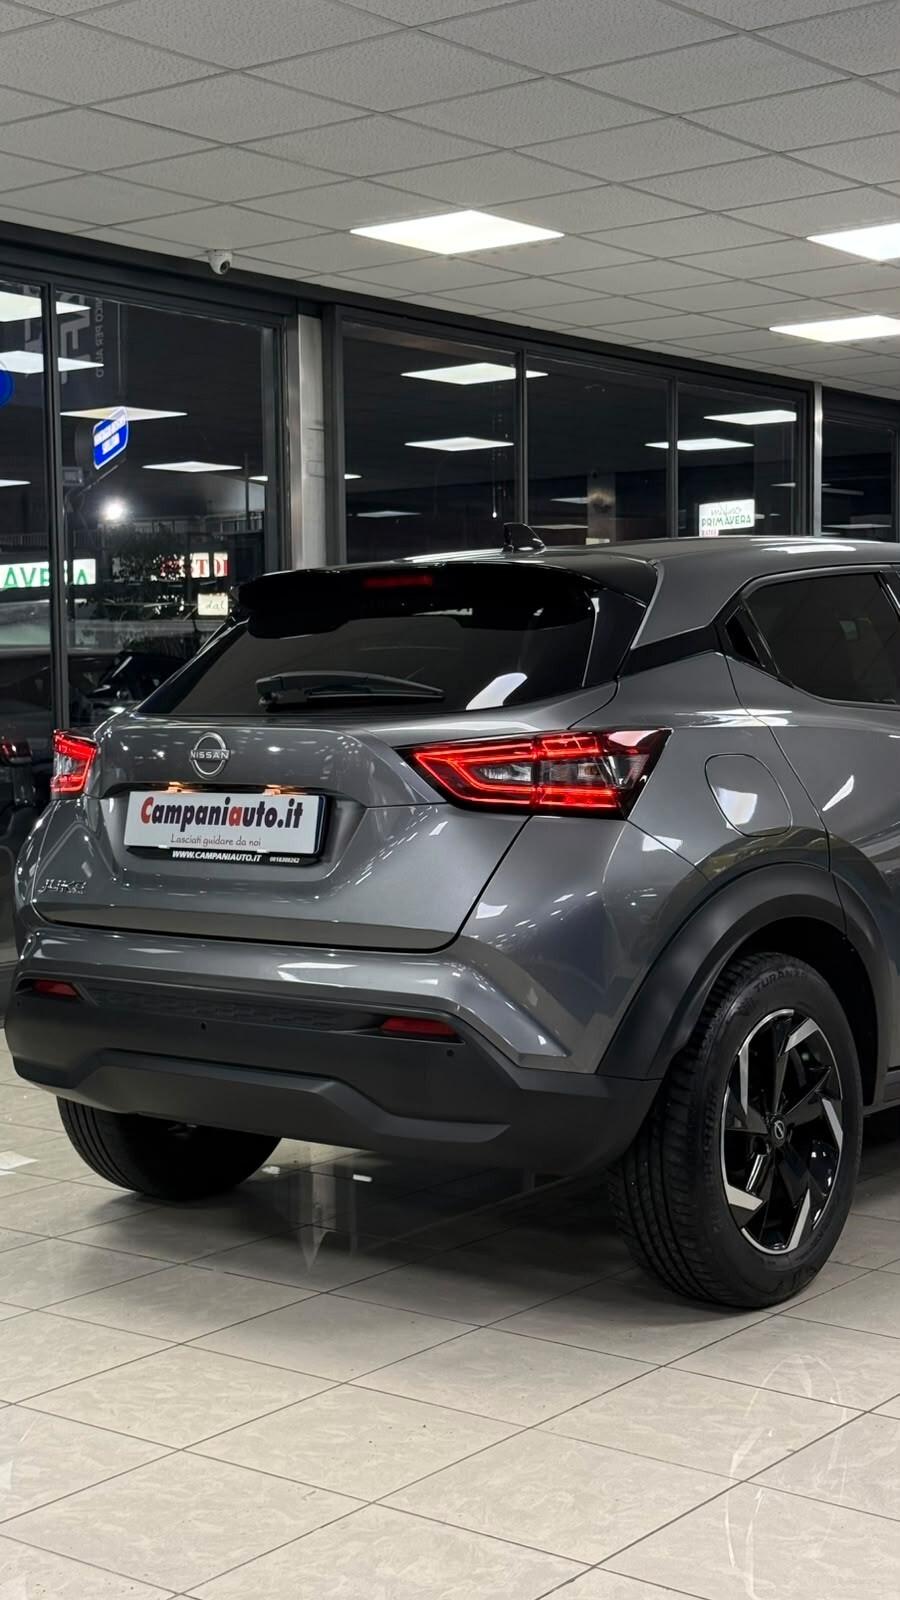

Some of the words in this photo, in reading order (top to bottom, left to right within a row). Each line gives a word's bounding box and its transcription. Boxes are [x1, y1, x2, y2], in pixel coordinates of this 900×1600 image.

[701, 514, 752, 528] PRIMAVERA
[190, 749, 230, 760] NISSAN
[140, 796, 304, 832] Campaniauto.it
[170, 833, 202, 845] Lasciati
[202, 834, 234, 847] guidare
[235, 835, 247, 847] da
[249, 836, 261, 847] noi
[171, 850, 262, 863] WWW.CAMPANIAUTO.IT
